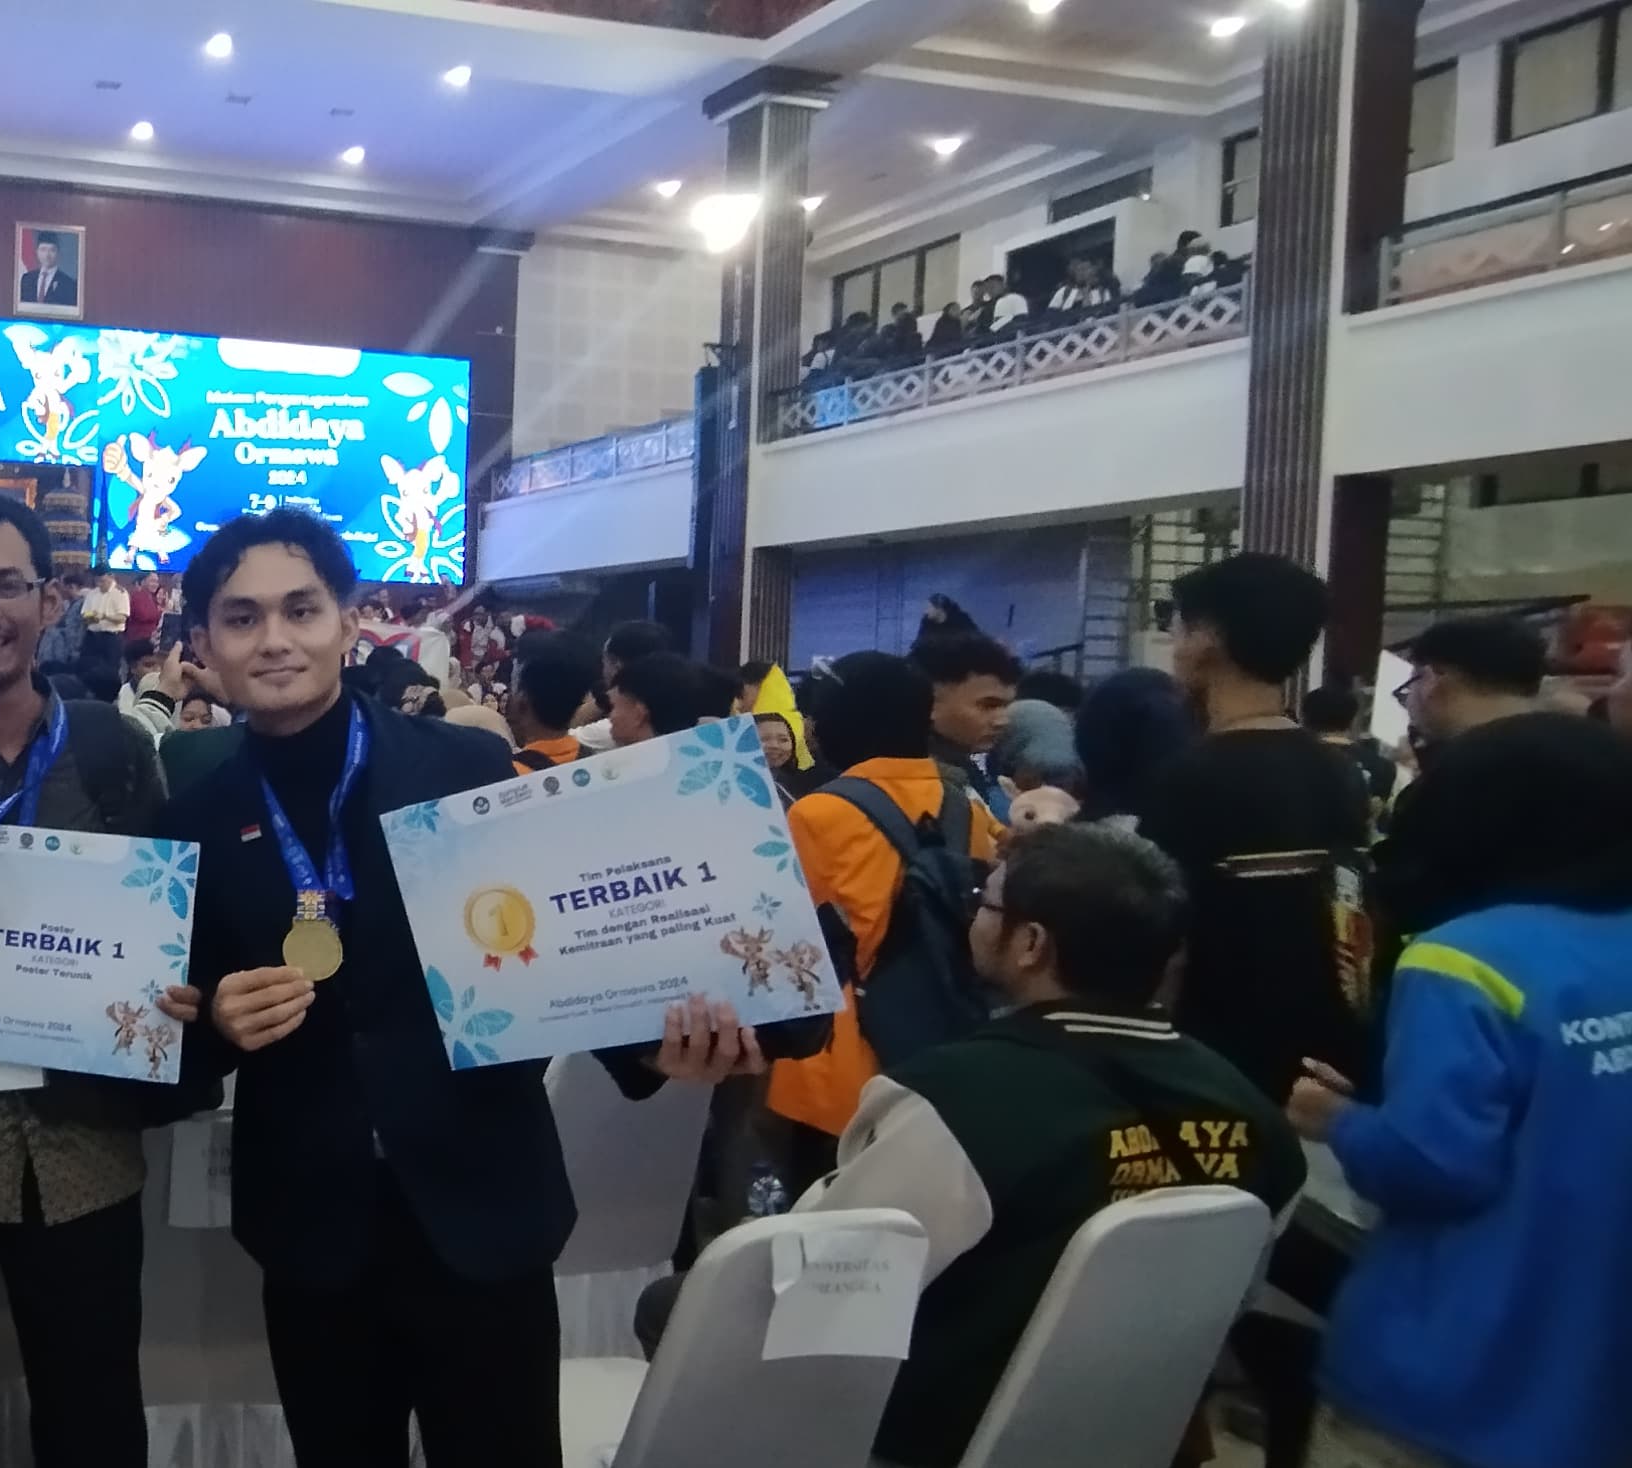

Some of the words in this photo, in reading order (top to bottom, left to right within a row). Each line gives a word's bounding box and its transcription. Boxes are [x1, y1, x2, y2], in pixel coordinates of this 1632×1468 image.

[209, 408, 366, 448] Abdidaya
[235, 442, 338, 466] Ormawa
[579, 870, 602, 882] Tim
[605, 855, 672, 877] Pelaksana
[549, 866, 688, 914] TERBAIK
[697, 861, 717, 883] 1
[608, 898, 667, 919] KATEGORI
[40, 923, 75, 934] Poster
[559, 936, 623, 956] Kemitraan
[626, 928, 658, 945] yang
[660, 920, 702, 937] paling
[703, 912, 737, 927] Kuat
[574, 929, 598, 940] Tim
[601, 917, 647, 934] dengan
[112, 942, 125, 959] 1
[16, 964, 50, 975] Poster
[53, 968, 92, 980] Terunik
[658, 975, 689, 993] 2024
